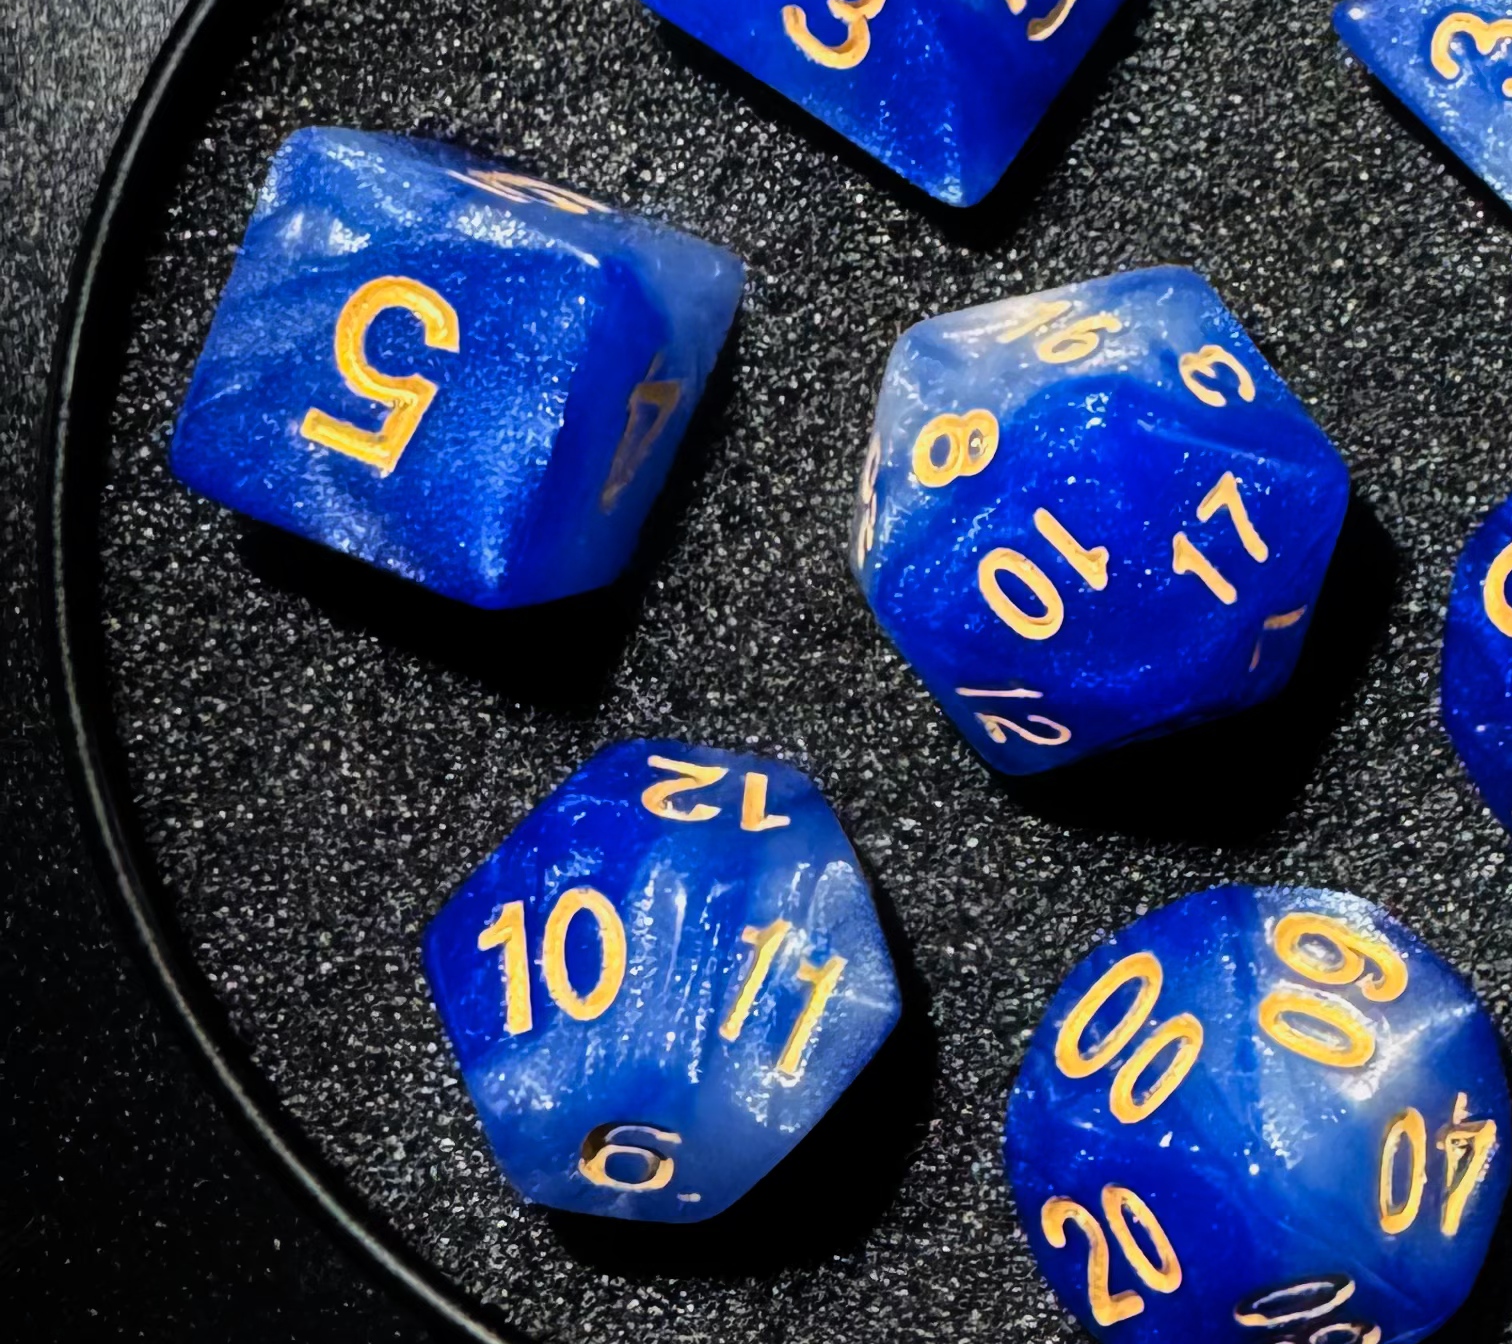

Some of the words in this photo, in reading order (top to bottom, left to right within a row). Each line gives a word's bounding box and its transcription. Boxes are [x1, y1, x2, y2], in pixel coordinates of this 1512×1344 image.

[301, 275, 460, 479] 5
[1179, 344, 1255, 407] 3
[912, 408, 999, 487] 8
[978, 507, 1110, 640] 10
[1173, 471, 1269, 605] 17
[955, 687, 1072, 745] 12
[641, 755, 791, 831] 12
[478, 886, 627, 1036] 10
[719, 919, 848, 1075] 11
[1055, 952, 1203, 1123] 00
[1379, 1092, 1498, 1237] 40
[1041, 1182, 1182, 1326] 20
